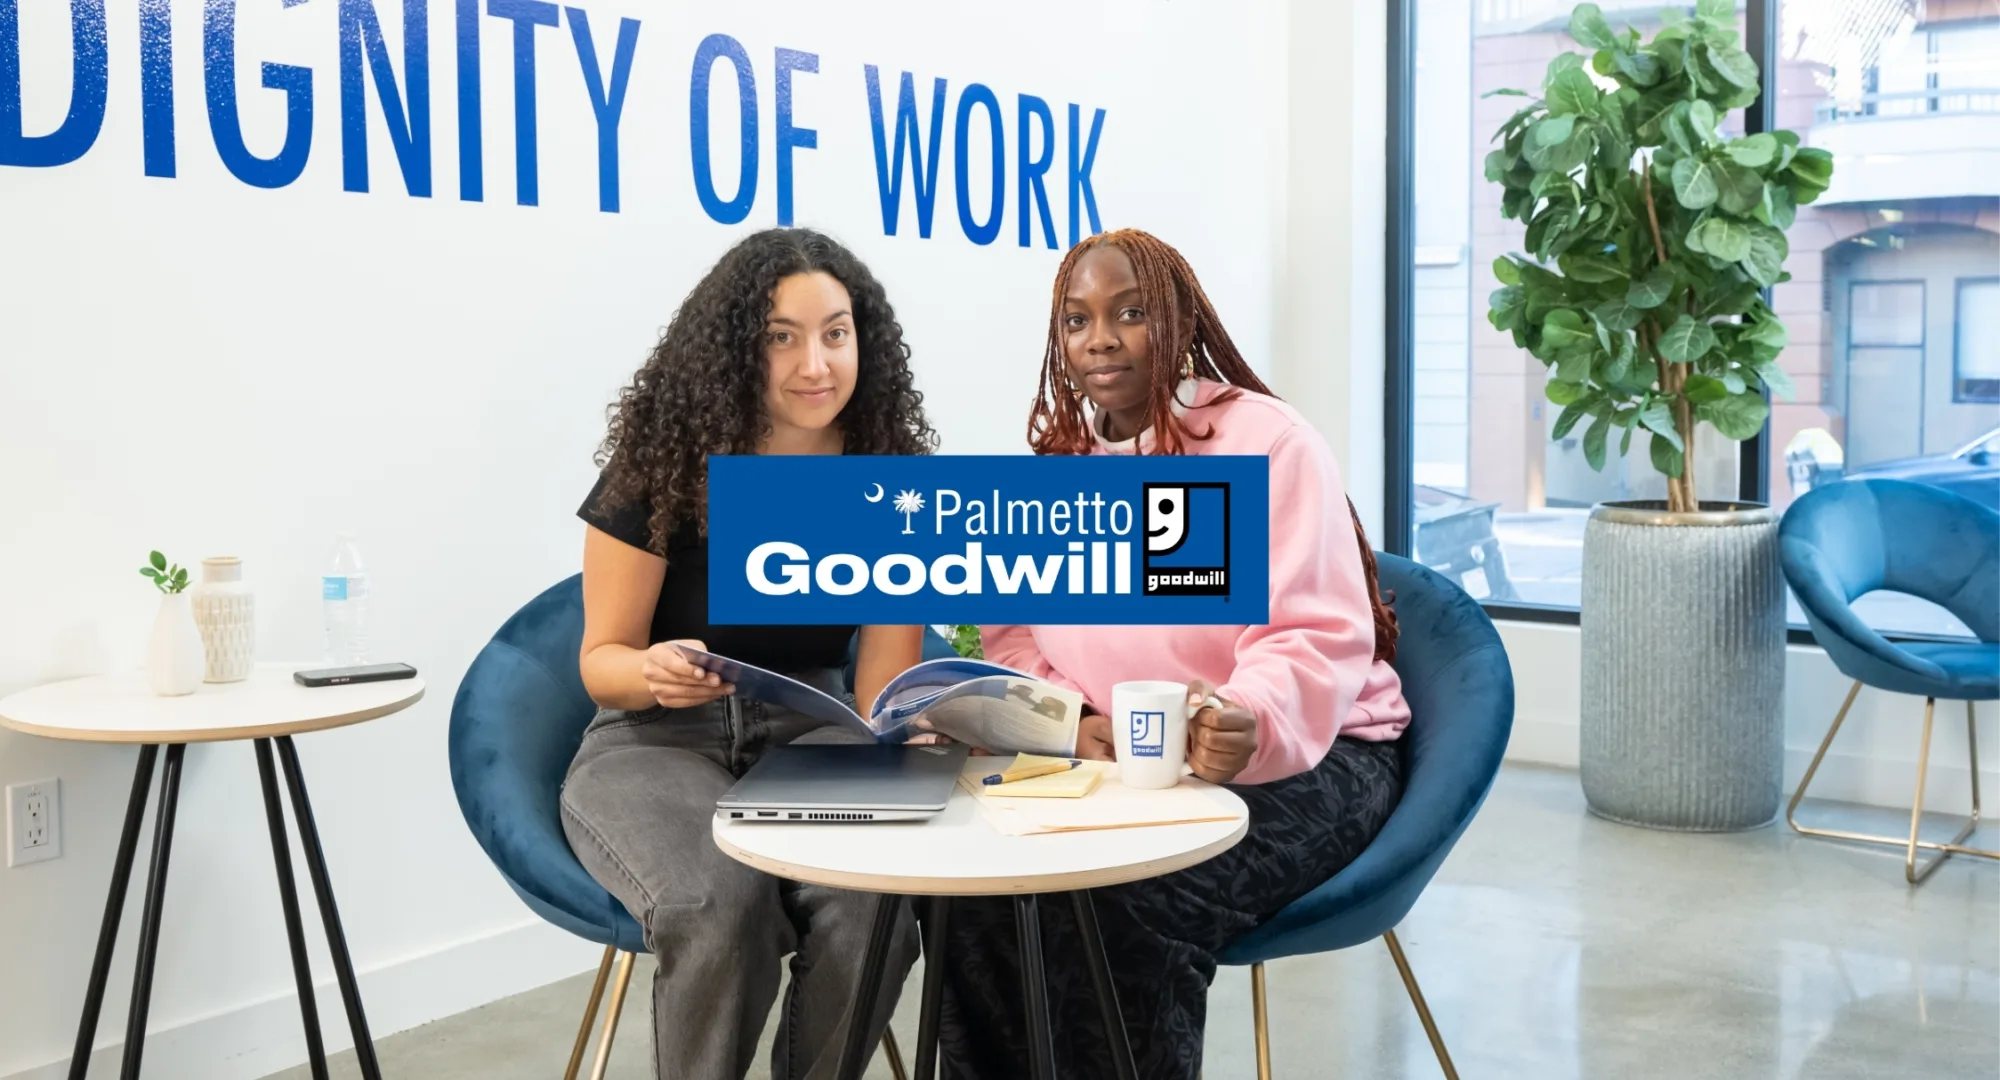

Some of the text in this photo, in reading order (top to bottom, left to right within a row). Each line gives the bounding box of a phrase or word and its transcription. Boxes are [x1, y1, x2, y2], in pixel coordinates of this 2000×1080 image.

[0, 0, 1107, 250] DIGNITY OF WORK
